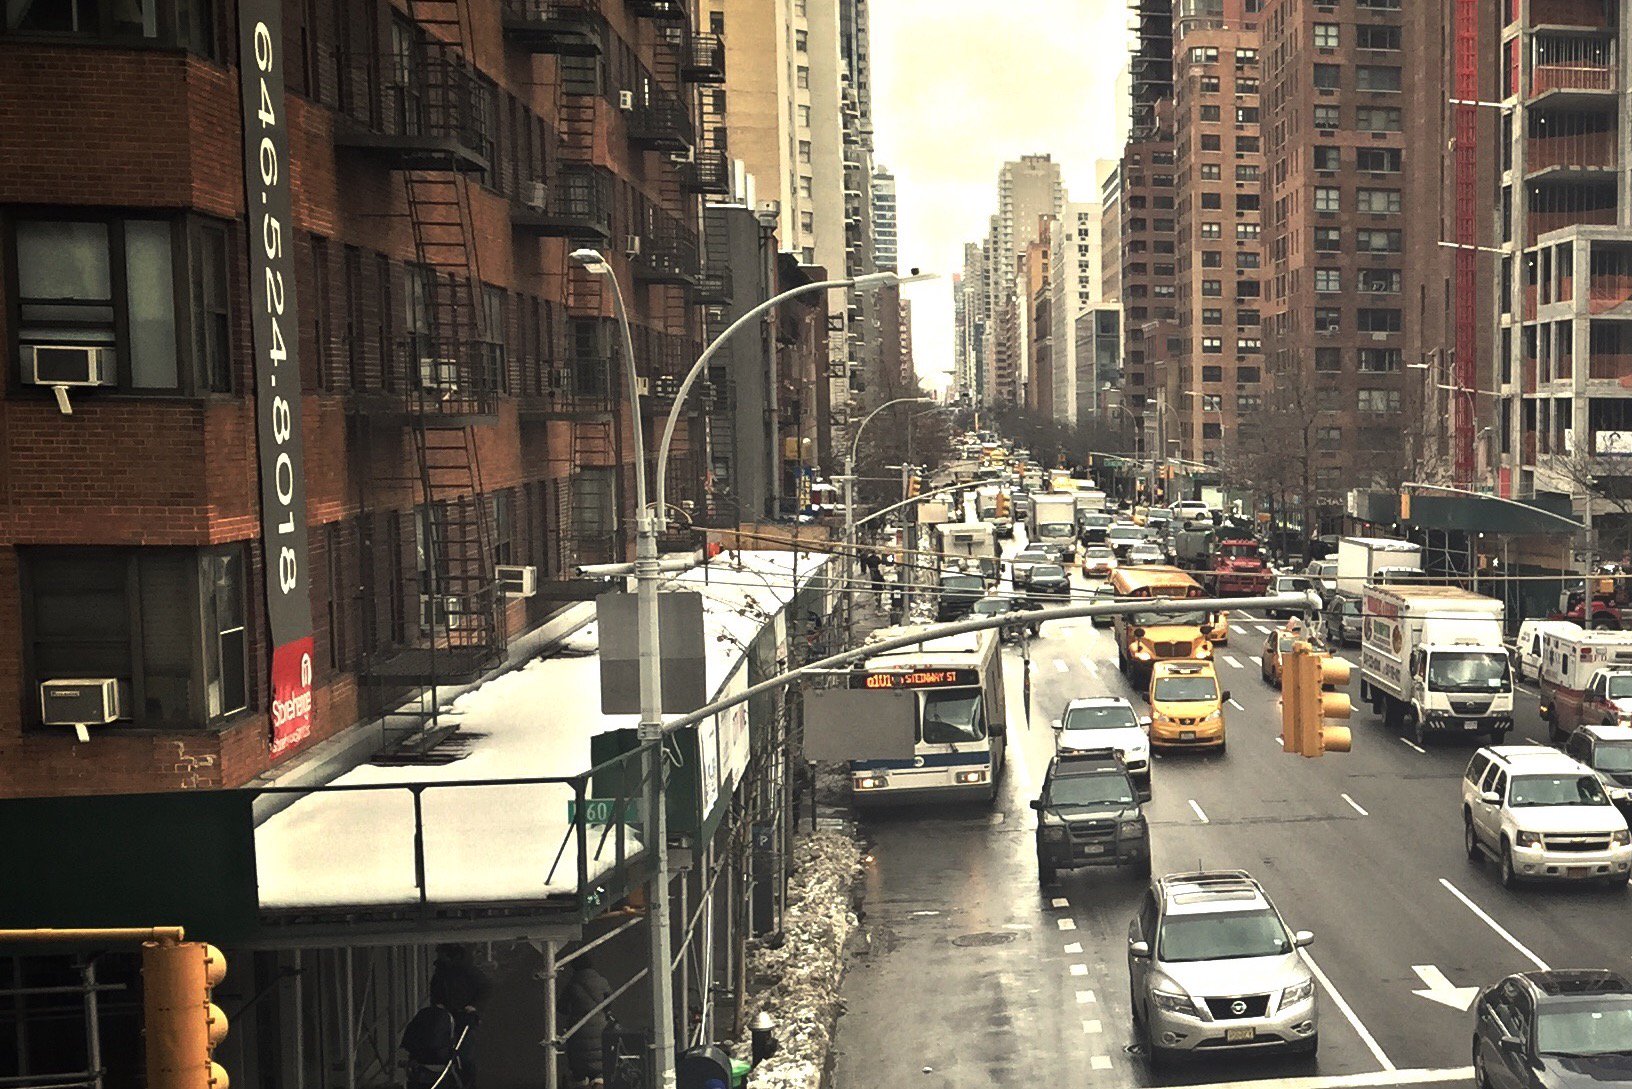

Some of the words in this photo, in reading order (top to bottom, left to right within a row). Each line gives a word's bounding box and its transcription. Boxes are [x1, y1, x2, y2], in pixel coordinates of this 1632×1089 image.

[254, 22, 297, 595] 646.524.8018
[946, 671, 956, 682] ST
[586, 803, 607, 820] 60
